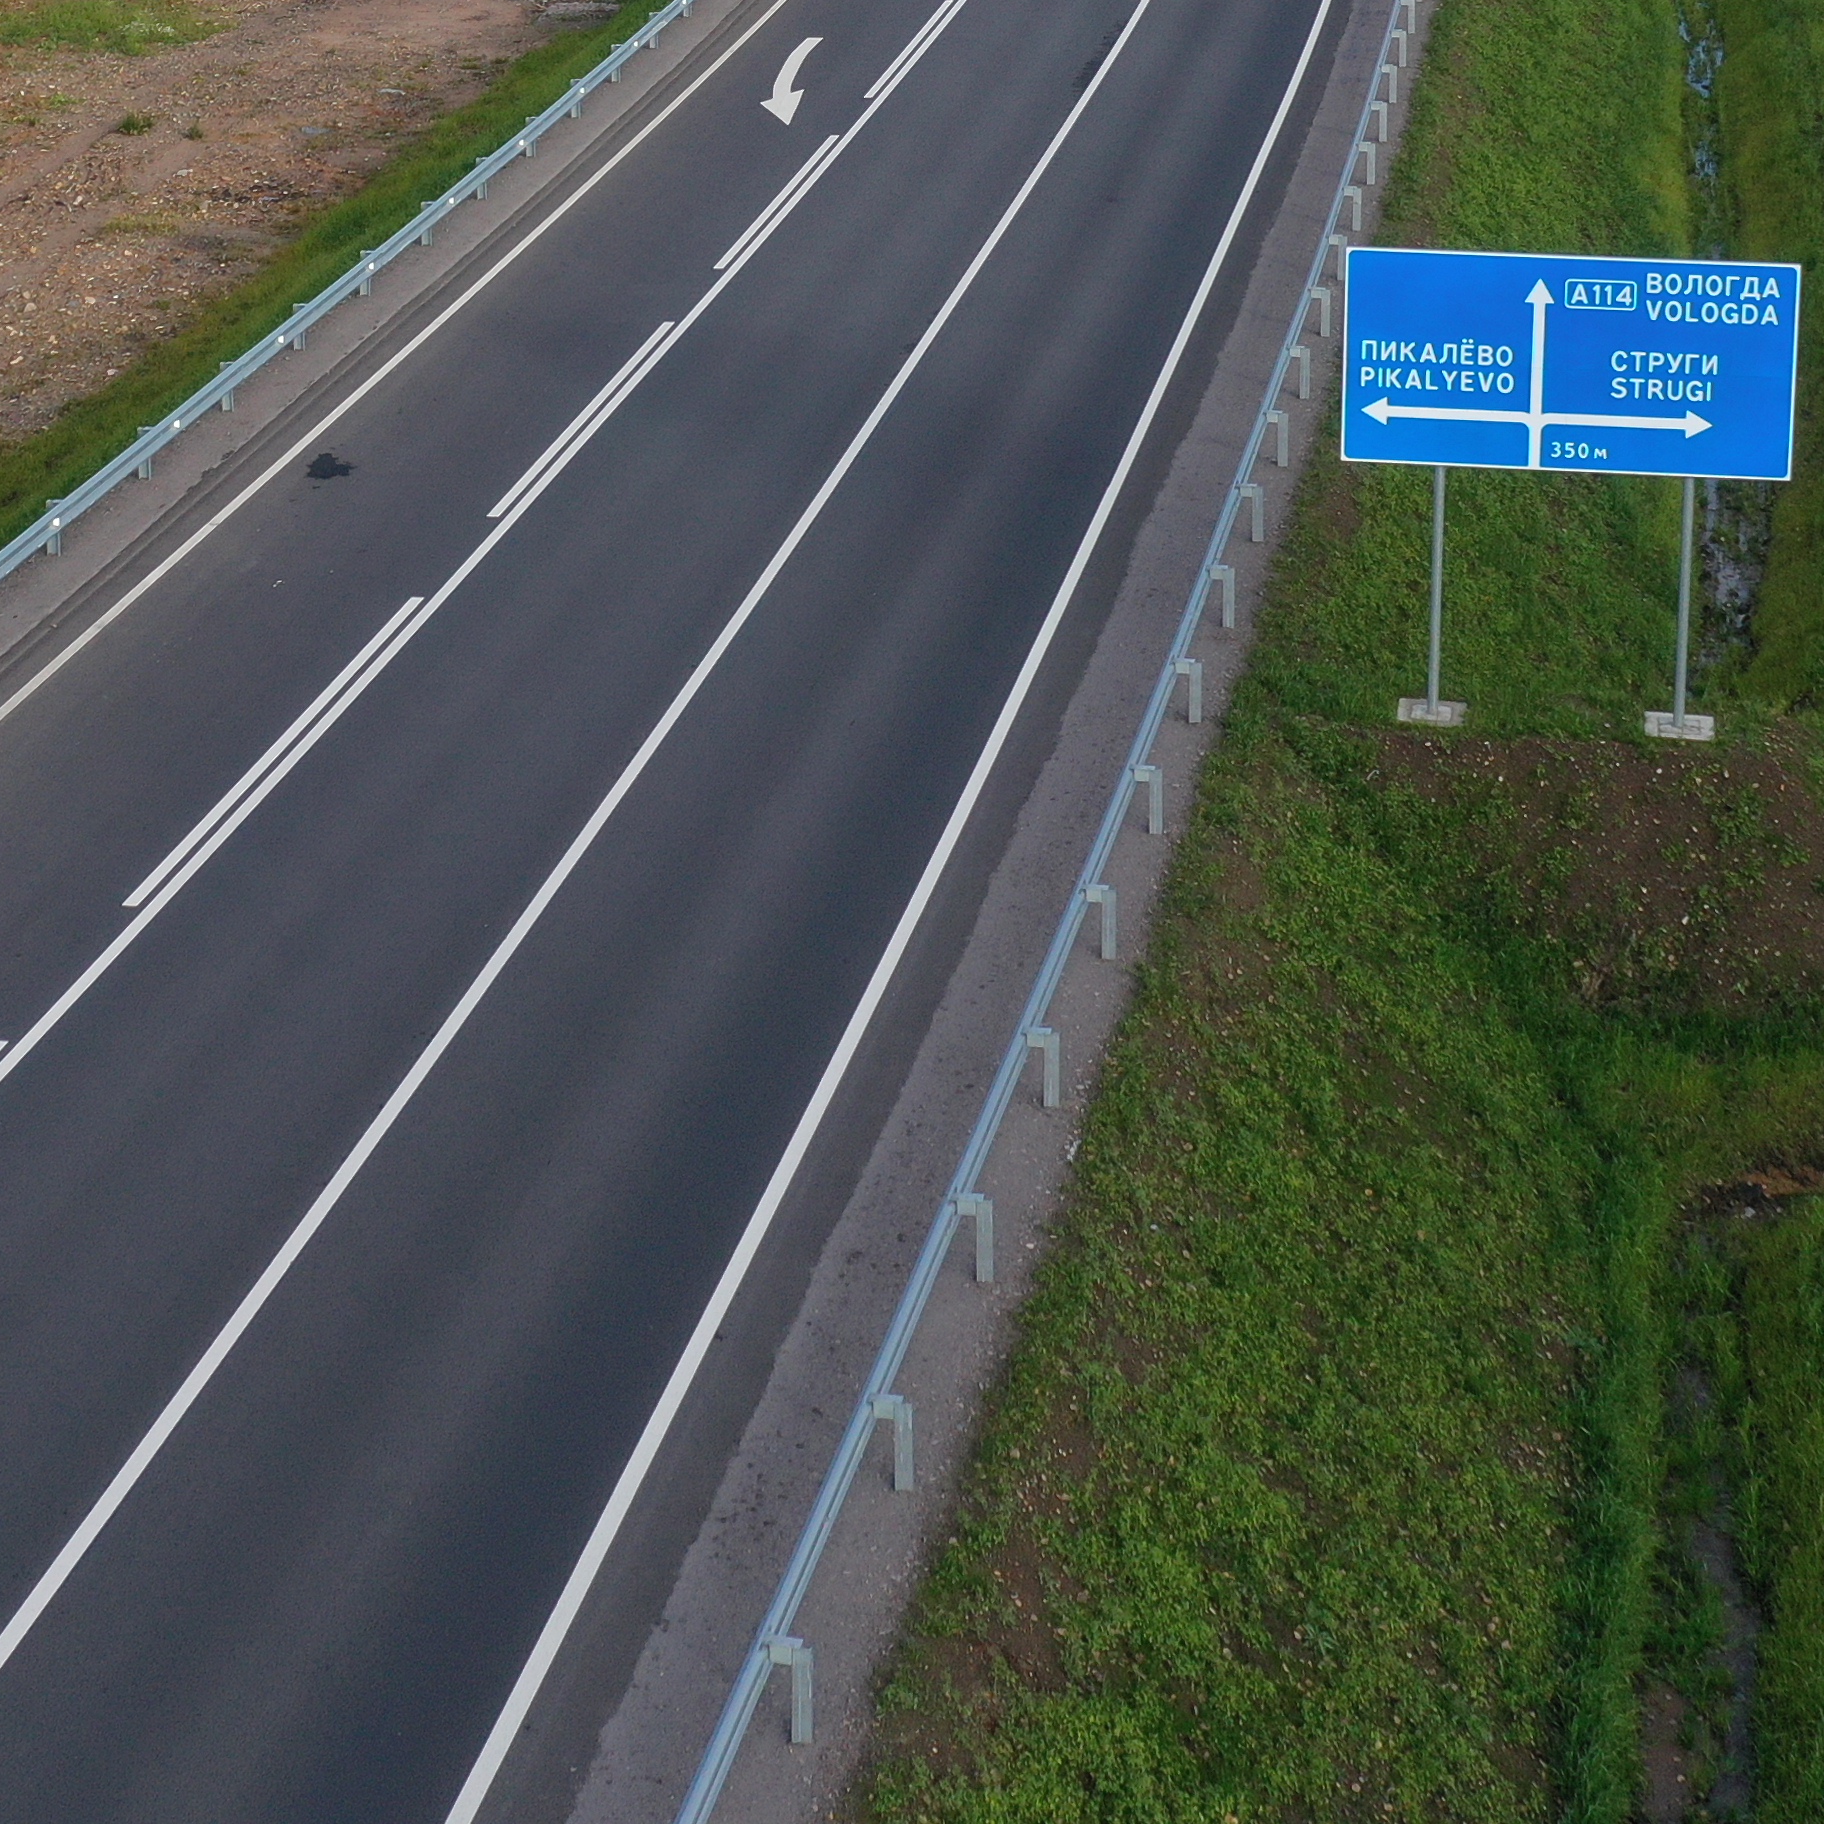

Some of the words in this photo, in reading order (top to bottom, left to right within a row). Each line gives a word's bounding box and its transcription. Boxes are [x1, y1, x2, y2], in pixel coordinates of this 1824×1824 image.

[1646, 273, 1780, 301] ВОЛОГДА
[1646, 300, 1779, 325] VOLOGDA
[1361, 338, 1514, 367] ПИКАЛЁВО
[1610, 350, 1718, 375] СТРУГИ
[1360, 366, 1515, 394] PIKALYEVO
[1610, 377, 1712, 402] STRUGI
